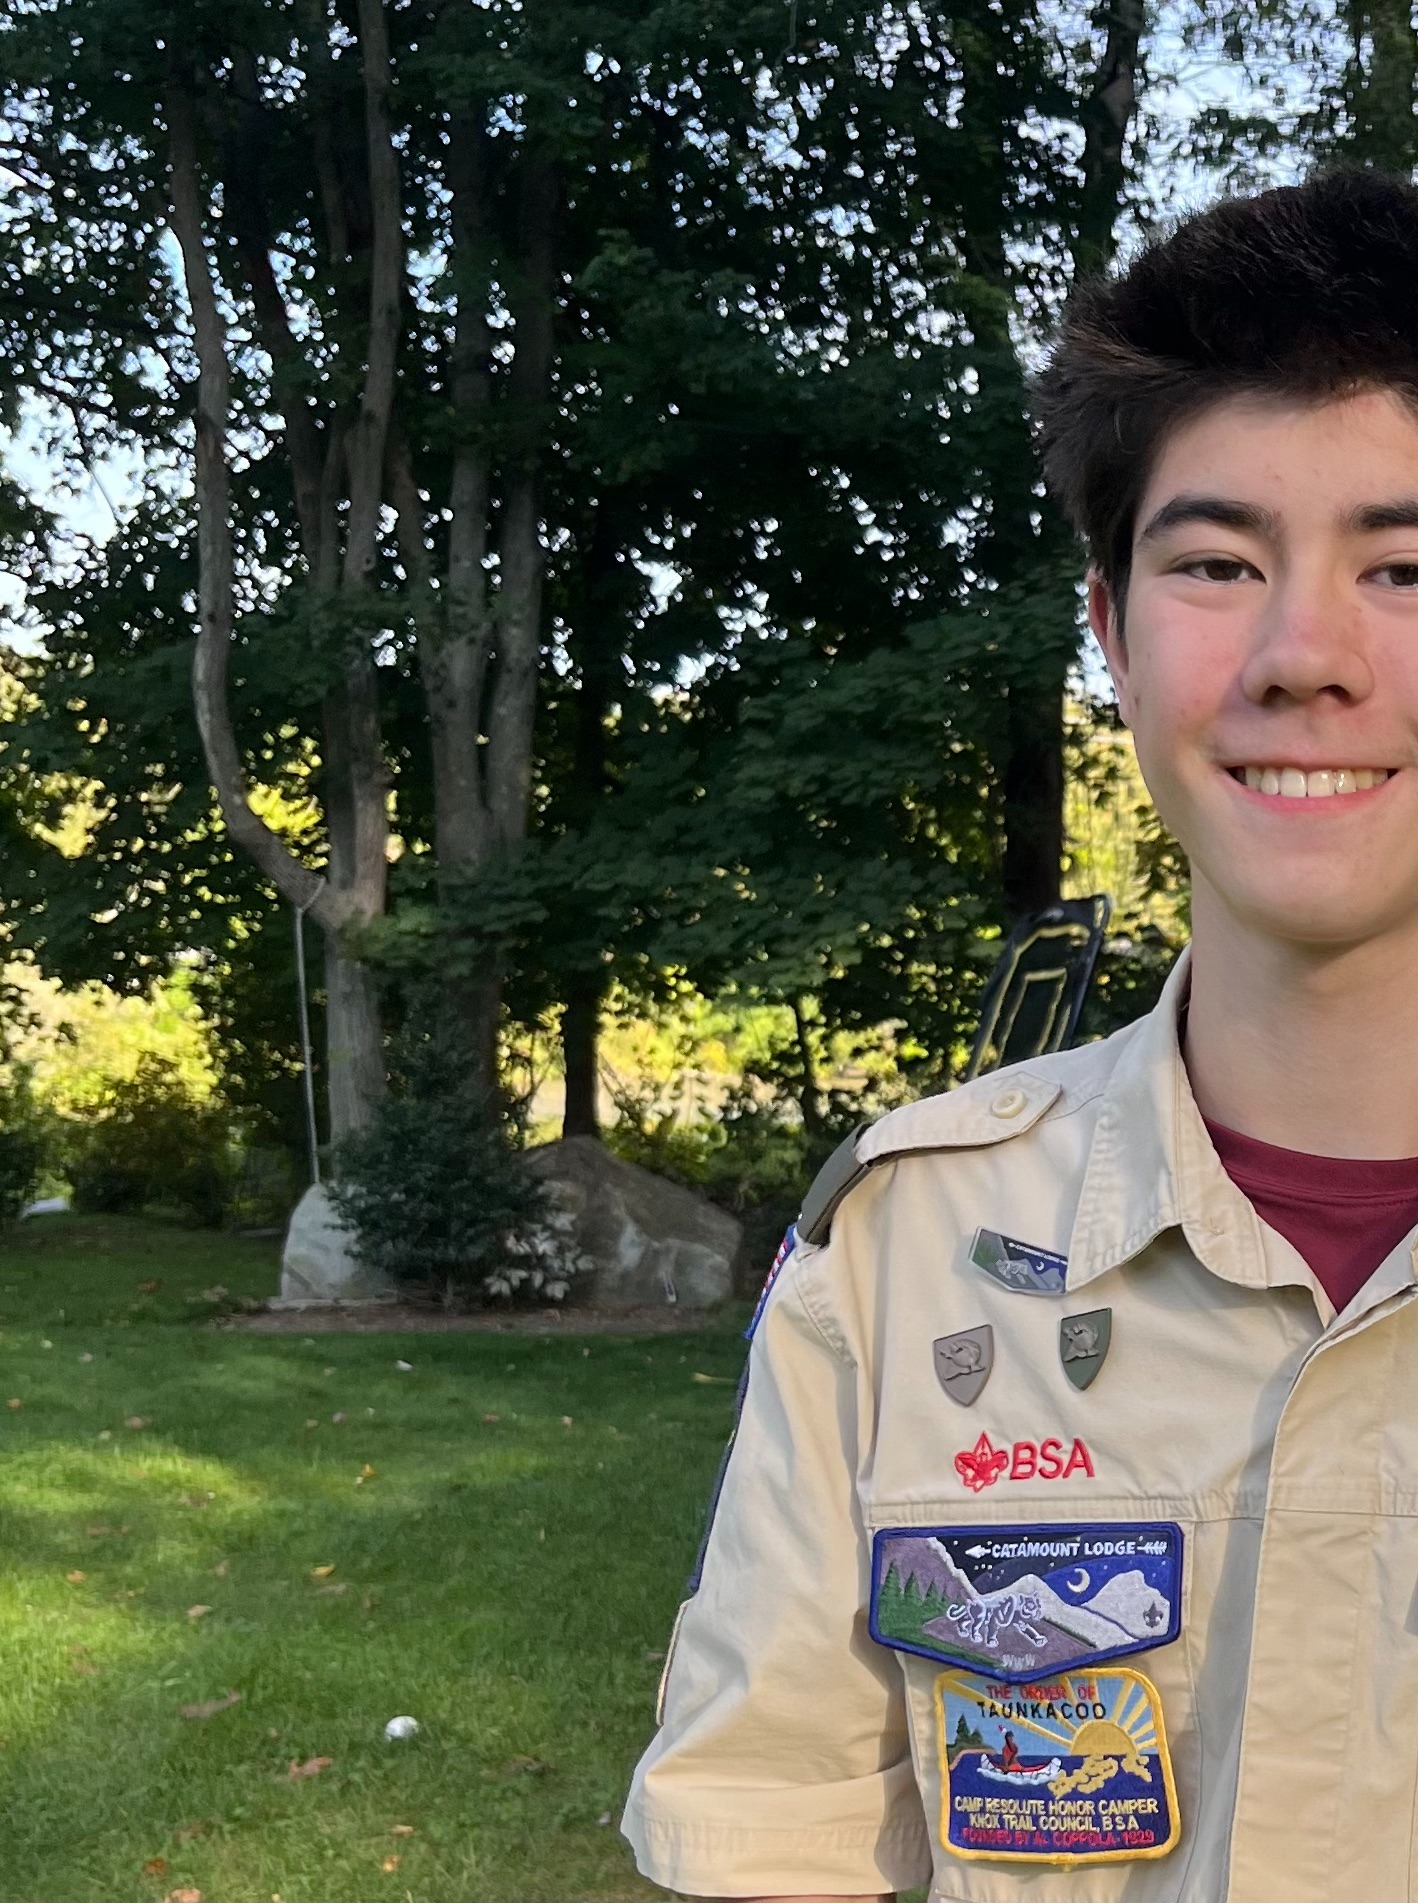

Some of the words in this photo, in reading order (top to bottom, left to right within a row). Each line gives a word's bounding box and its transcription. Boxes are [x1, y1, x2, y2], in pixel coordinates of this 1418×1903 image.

[1009, 1437, 1095, 1481] BSA
[991, 1541, 1080, 1558] CATAMOUNT
[1084, 1540, 1136, 1556] LODGE
[985, 1684, 1012, 1700] THE
[1077, 1684, 1097, 1700] OF
[954, 1796, 983, 1812] CAMP
[985, 1797, 1046, 1815] RESOLUTE
[1048, 1800, 1096, 1816] HONOR
[1098, 1798, 1159, 1816] CAMPER
[969, 1813, 1000, 1829] KNOX
[1002, 1814, 1037, 1831] TRAIL
